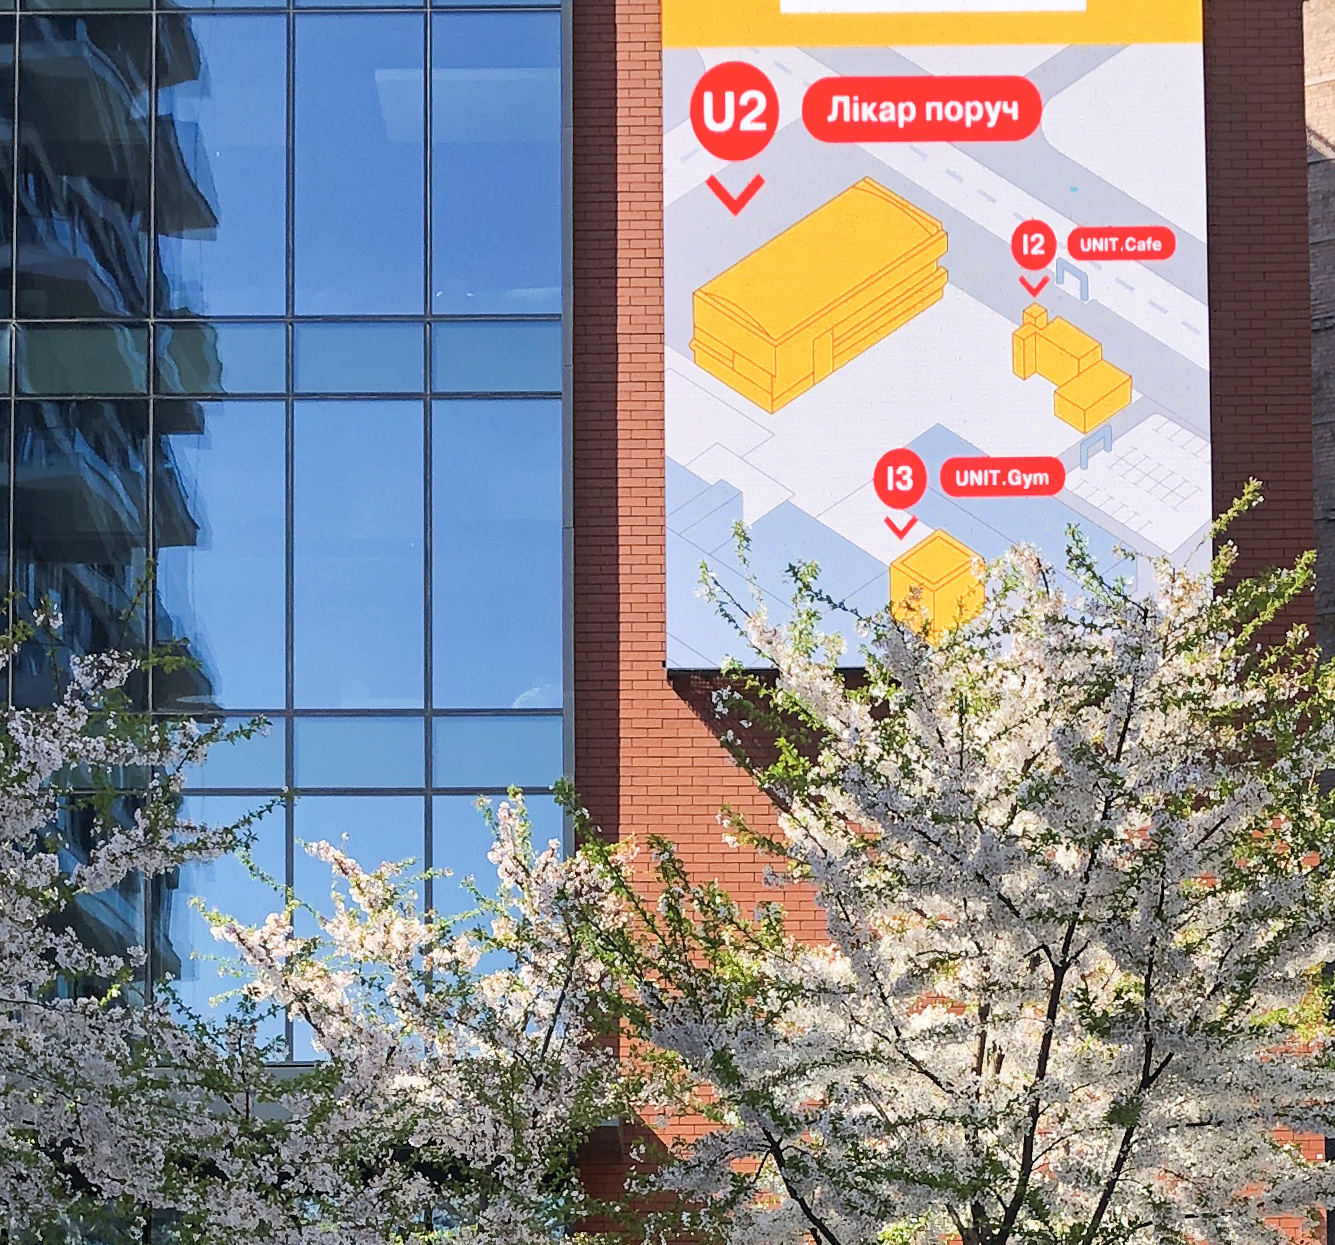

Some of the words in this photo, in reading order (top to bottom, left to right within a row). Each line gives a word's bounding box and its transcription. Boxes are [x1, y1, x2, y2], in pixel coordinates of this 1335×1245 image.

[703, 89, 767, 132] U2
[826, 95, 917, 129] Лікар
[925, 100, 1019, 128] поруч
[1080, 236, 1163, 253] UNIT.Cafe
[955, 468, 1050, 490] UNIT.Gym
